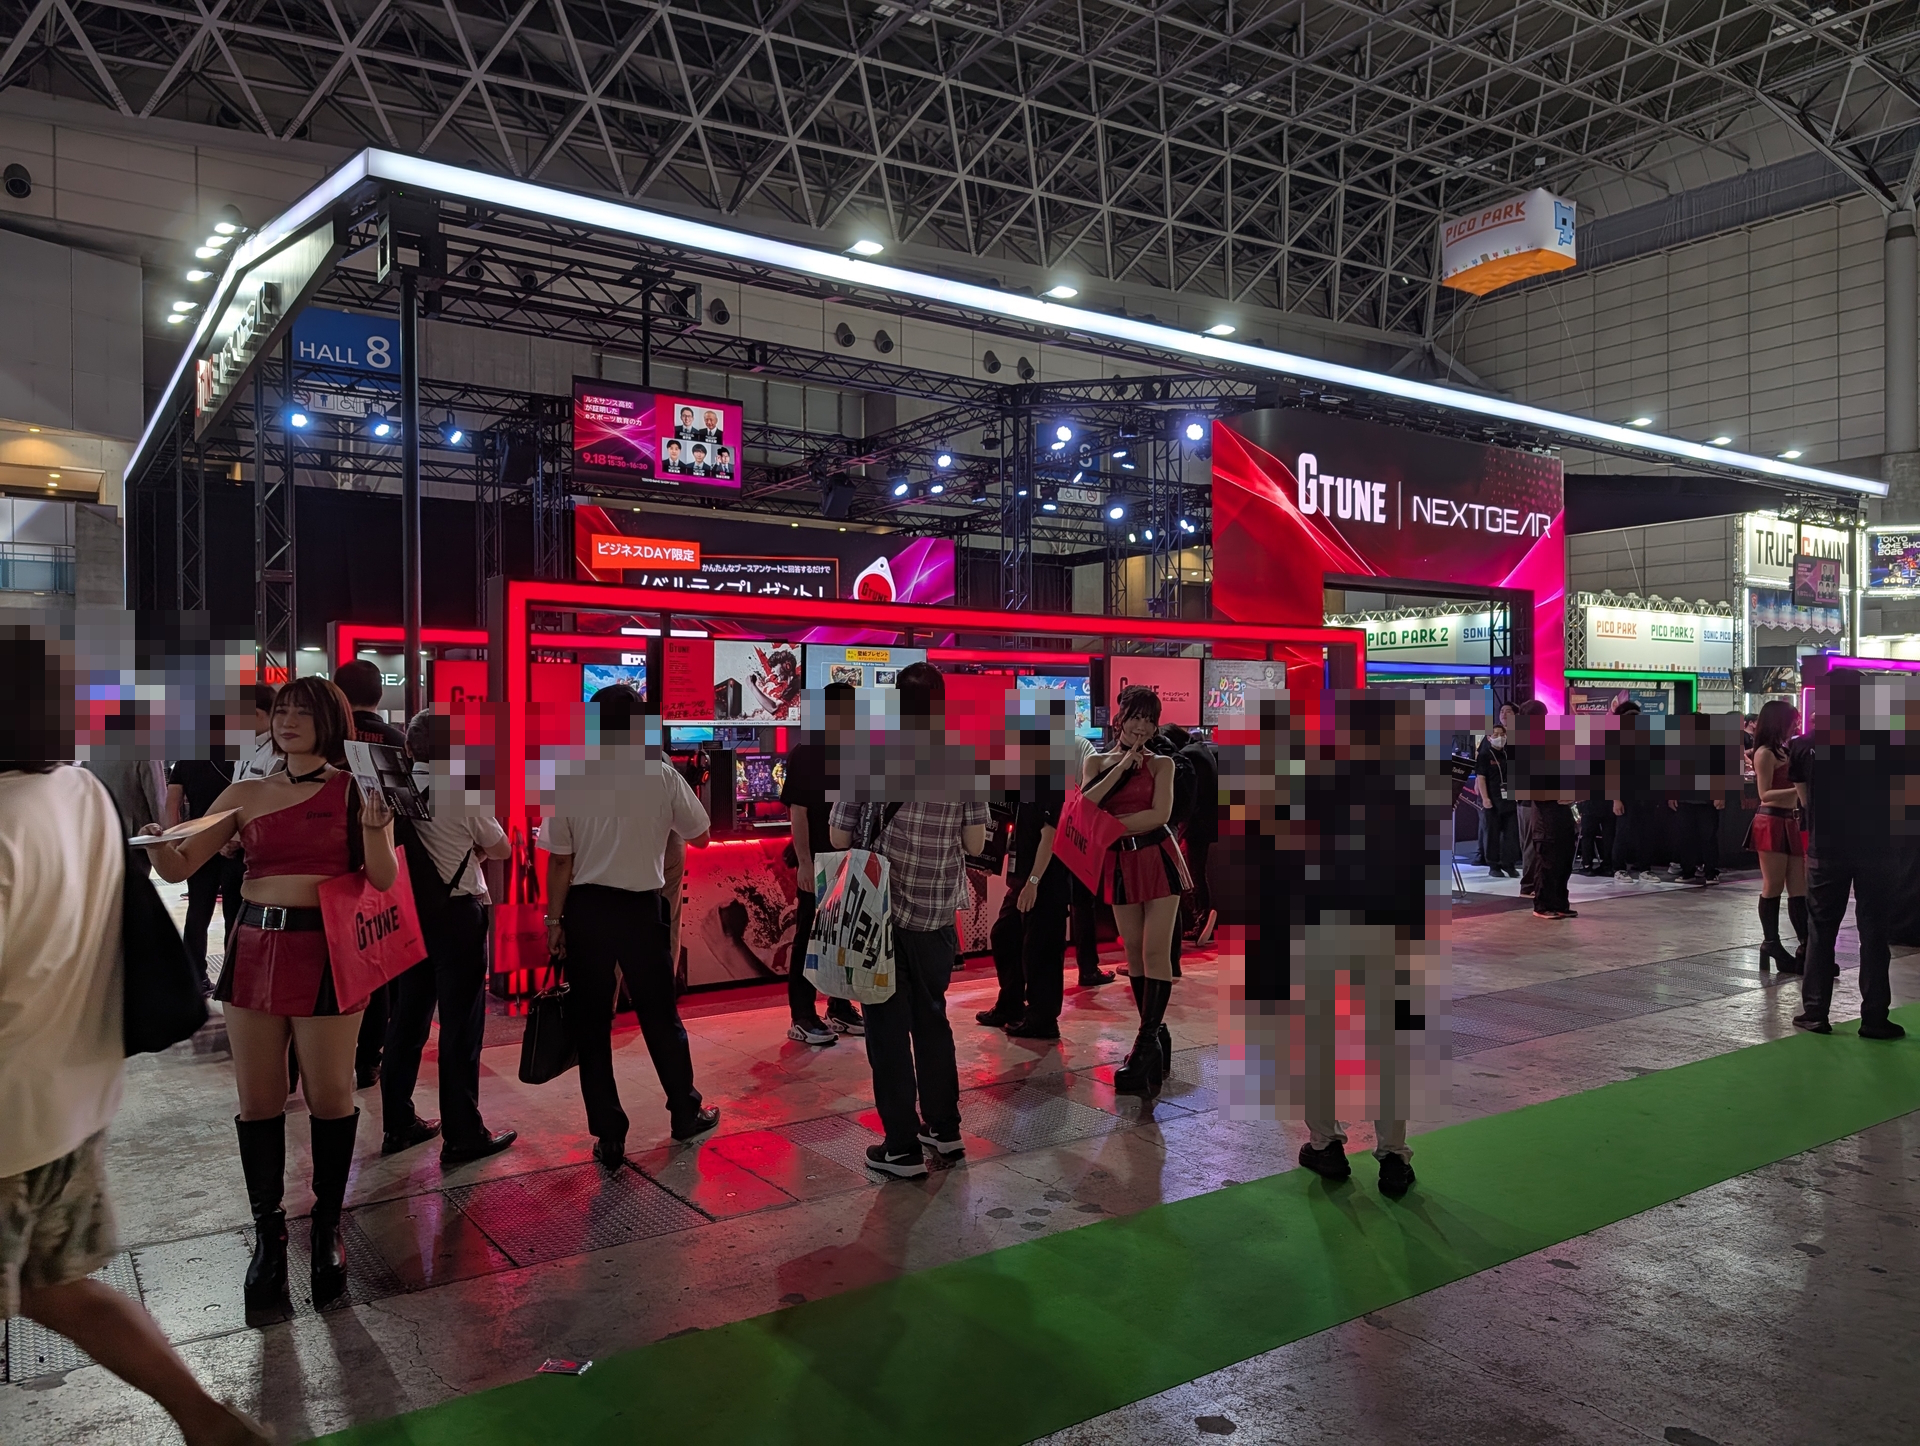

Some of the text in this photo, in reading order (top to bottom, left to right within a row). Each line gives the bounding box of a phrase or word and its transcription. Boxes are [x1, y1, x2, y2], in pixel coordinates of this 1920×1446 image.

[1446, 201, 1526, 243] PICO PARK
[299, 336, 391, 368] HALL 8
[585, 396, 634, 410] ルネサンス高校
[585, 413, 643, 427] eスポーツ教育の力
[582, 452, 607, 466] 9.18
[1412, 495, 1552, 539] NEXTGEAR
[597, 542, 695, 563] ビジネスDAY限定
[1756, 529, 1849, 575] TRUE GAMIN
[702, 563, 831, 574] かんたんなブースアンケートに回答するだけで
[1367, 627, 1449, 646] PICO PARK 2
[1596, 620, 1637, 635] PICO PARK
[1651, 624, 1695, 639] PICO PARK 2
[1703, 630, 1731, 641] SONIC PICO
[1219, 676, 1247, 691] めっちゃ
[1208, 687, 1245, 708] カメレオ
[1065, 814, 1089, 856] GTUNE
[356, 904, 400, 951] GTUNE
